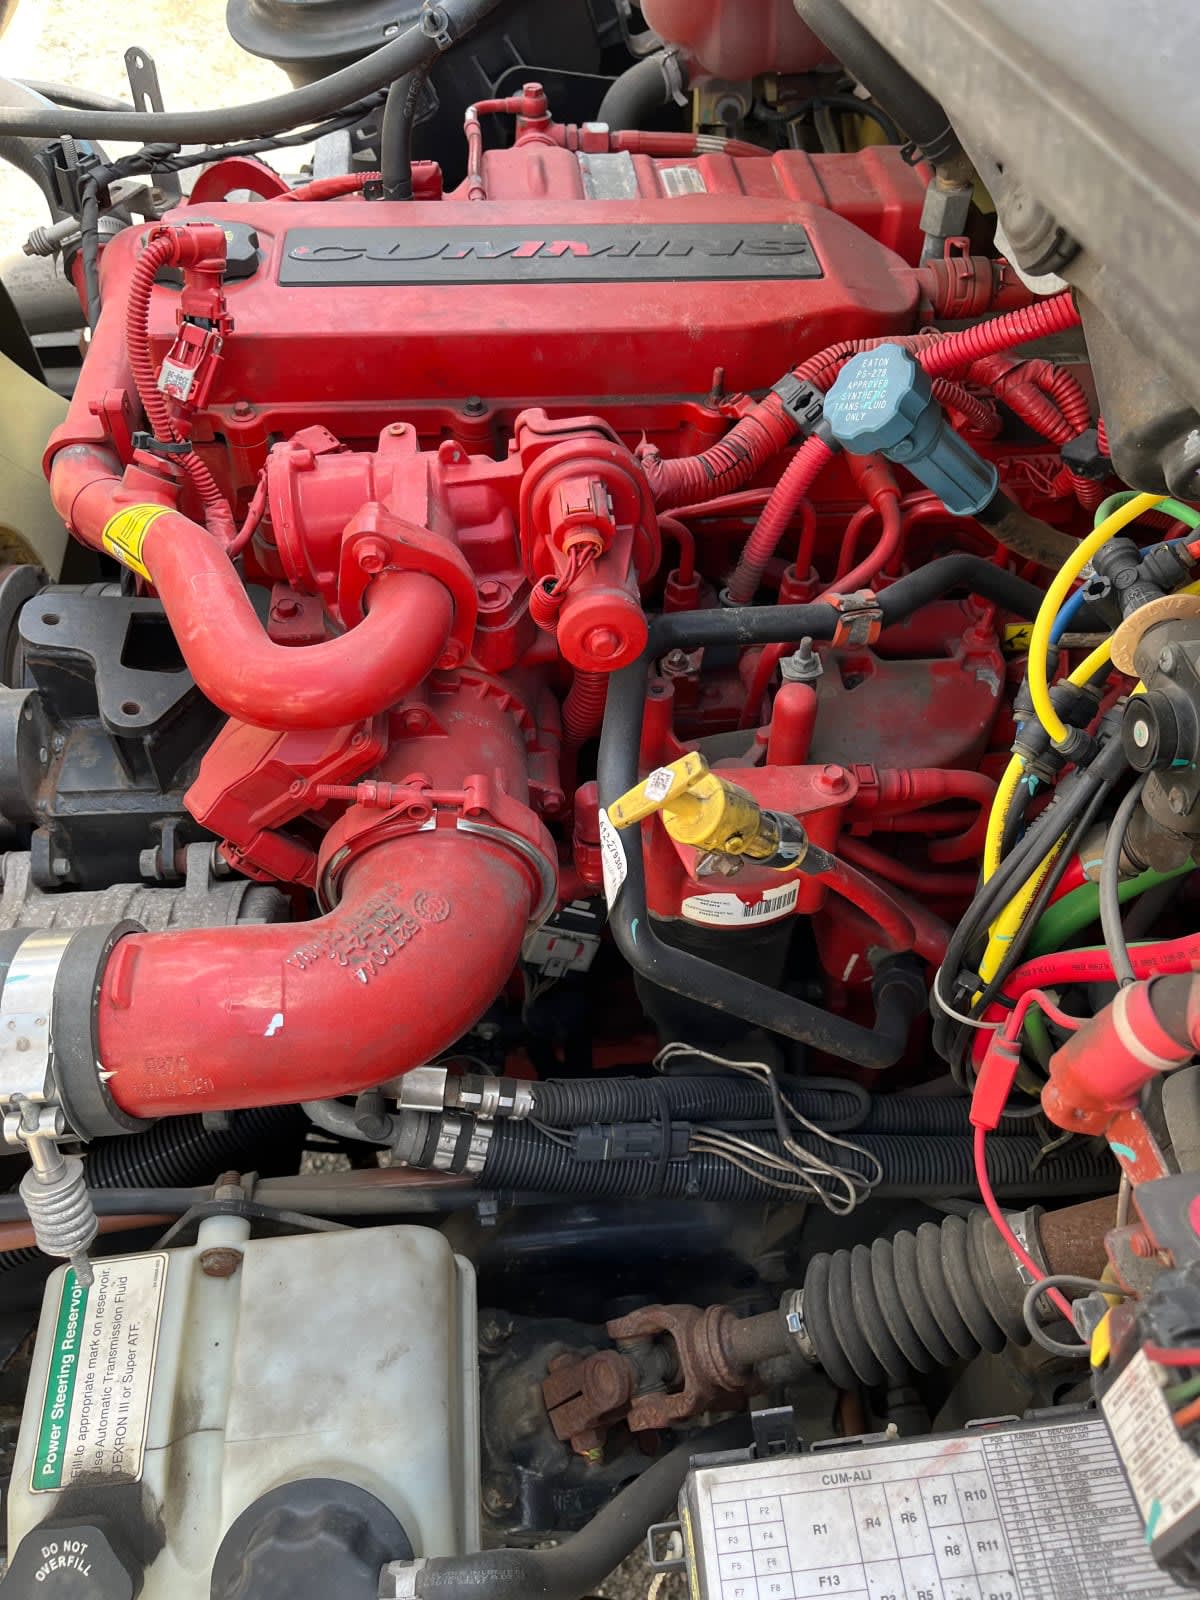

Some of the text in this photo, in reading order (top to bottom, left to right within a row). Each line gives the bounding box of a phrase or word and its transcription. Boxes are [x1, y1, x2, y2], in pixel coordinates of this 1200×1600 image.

[288, 239, 807, 262] CUMMINS
[862, 358, 890, 368] EATON
[840, 390, 887, 401] SYNTHETIC
[847, 379, 889, 390] APPROVED
[845, 412, 866, 422] ONLY
[115, 1276, 128, 1304] Fluid
[93, 1322, 102, 1337] on
[88, 1340, 100, 1369] mark
[103, 1305, 124, 1385] Transmission
[122, 1350, 137, 1383] Super
[51, 1353, 75, 1420] Steering
[123, 1386, 132, 1399] or
[78, 1372, 95, 1441] appropriate
[95, 1386, 113, 1448] Automatic
[42, 1424, 62, 1475] Power
[74, 1445, 85, 1457] to
[112, 1416, 128, 1473] DEXRON
[822, 1470, 872, 1486] CUM-ALI
[933, 1489, 987, 1506] R7 R10
[725, 1506, 917, 1535] F1 F2 R1 R4 R6
[41, 1540, 89, 1558] DO NOT
[728, 1532, 999, 1556] F3 F4 R8 R11
[35, 1555, 92, 1582] OVERFILL
[731, 1562, 742, 1570] F5
[818, 1575, 841, 1588] F13
[735, 1588, 745, 1598] F7
[770, 1584, 781, 1593] F8
[917, 1590, 934, 1600] R5
